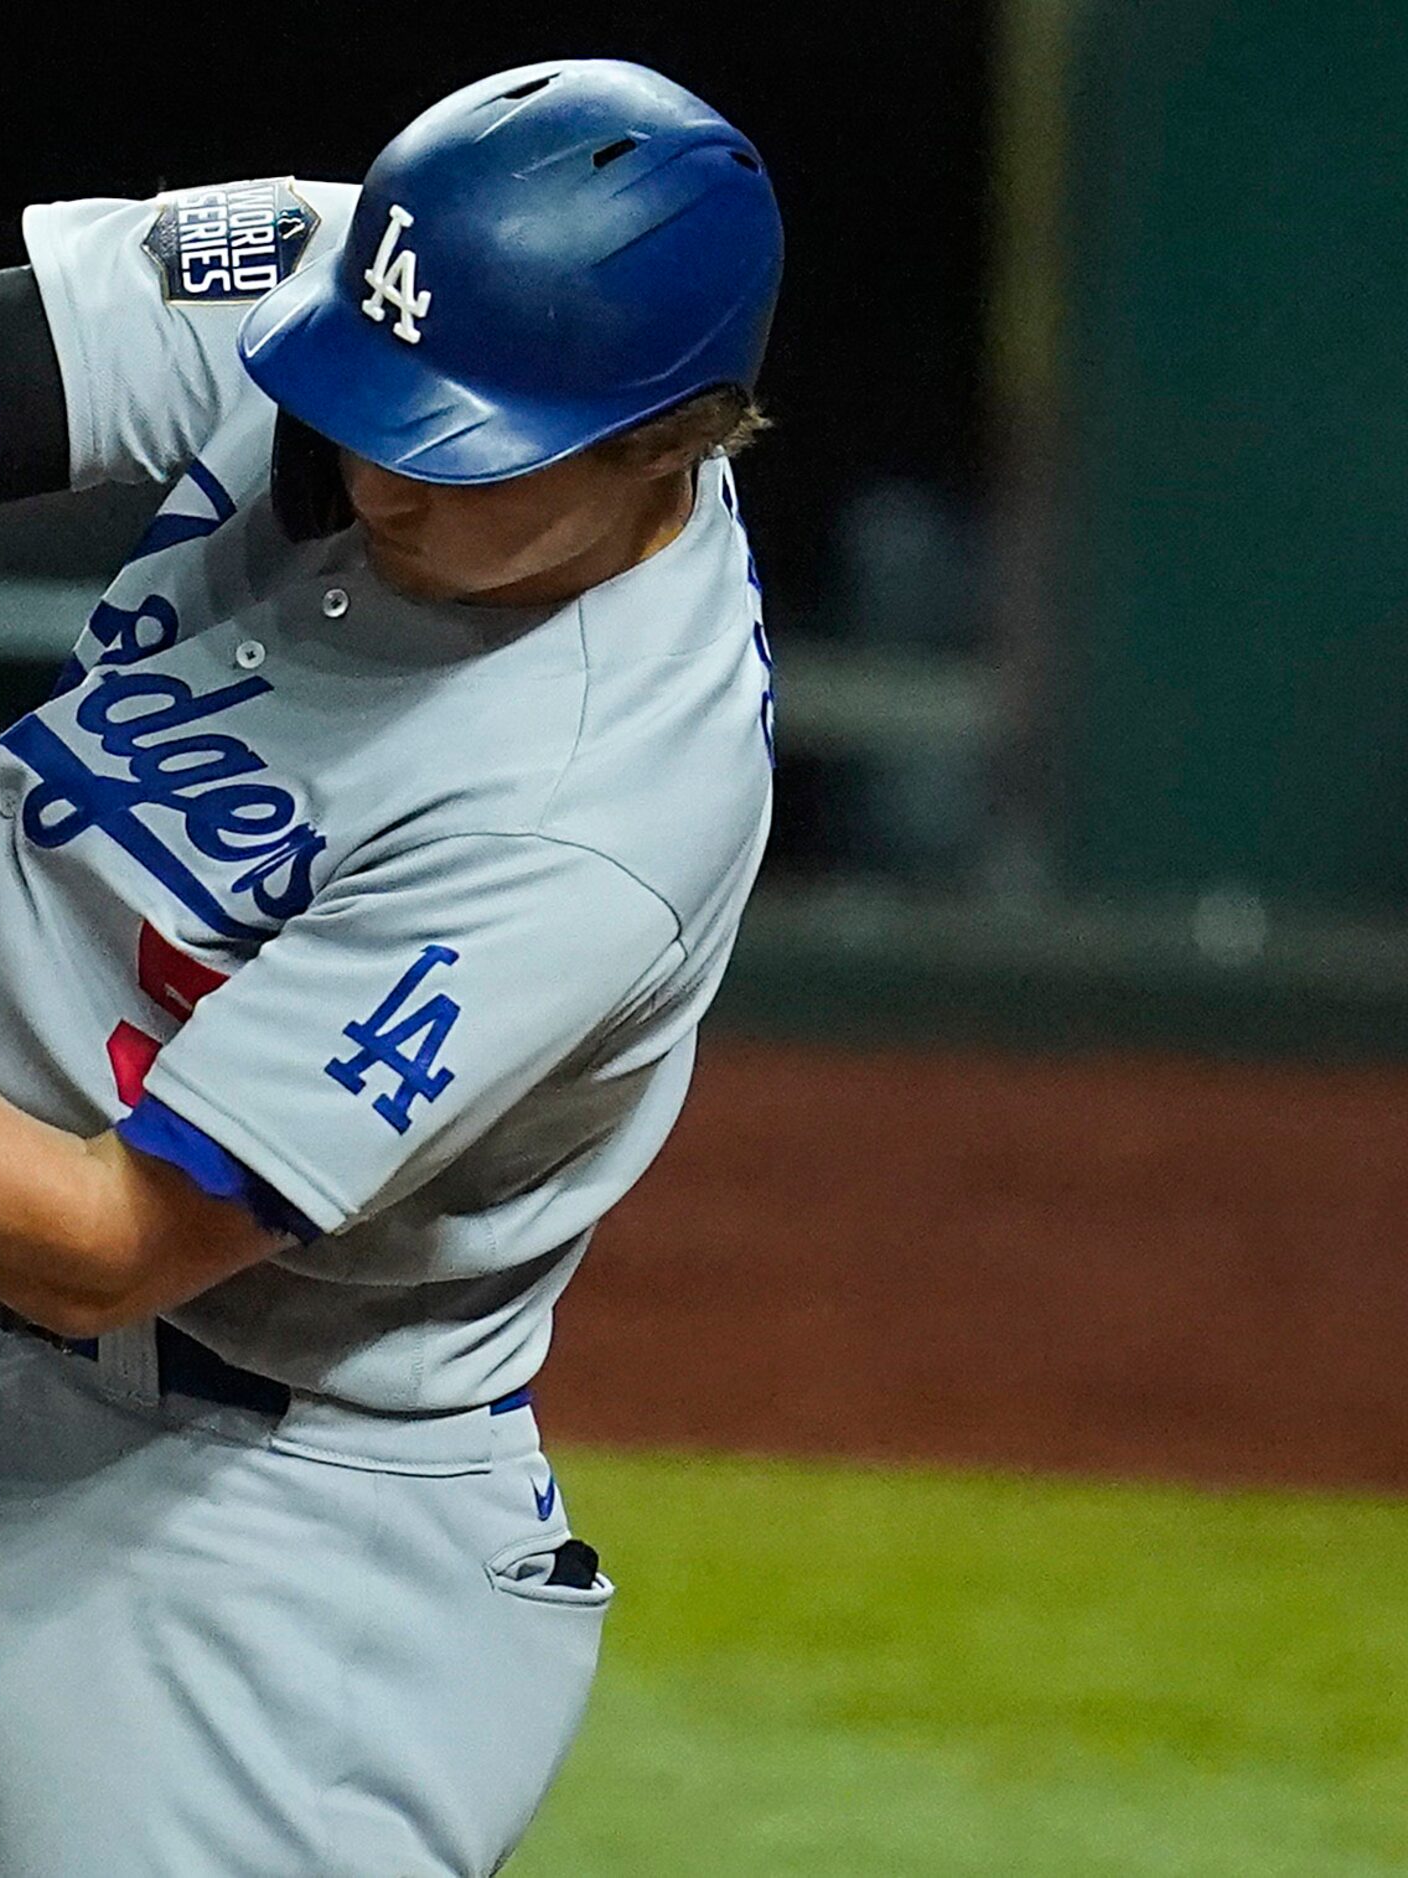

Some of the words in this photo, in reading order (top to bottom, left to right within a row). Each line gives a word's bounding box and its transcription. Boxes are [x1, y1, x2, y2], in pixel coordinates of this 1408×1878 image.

[177, 190, 231, 294] SERIES
[228, 185, 279, 292] WORLD
[362, 204, 432, 344] LA
[324, 944, 461, 1136] LA
